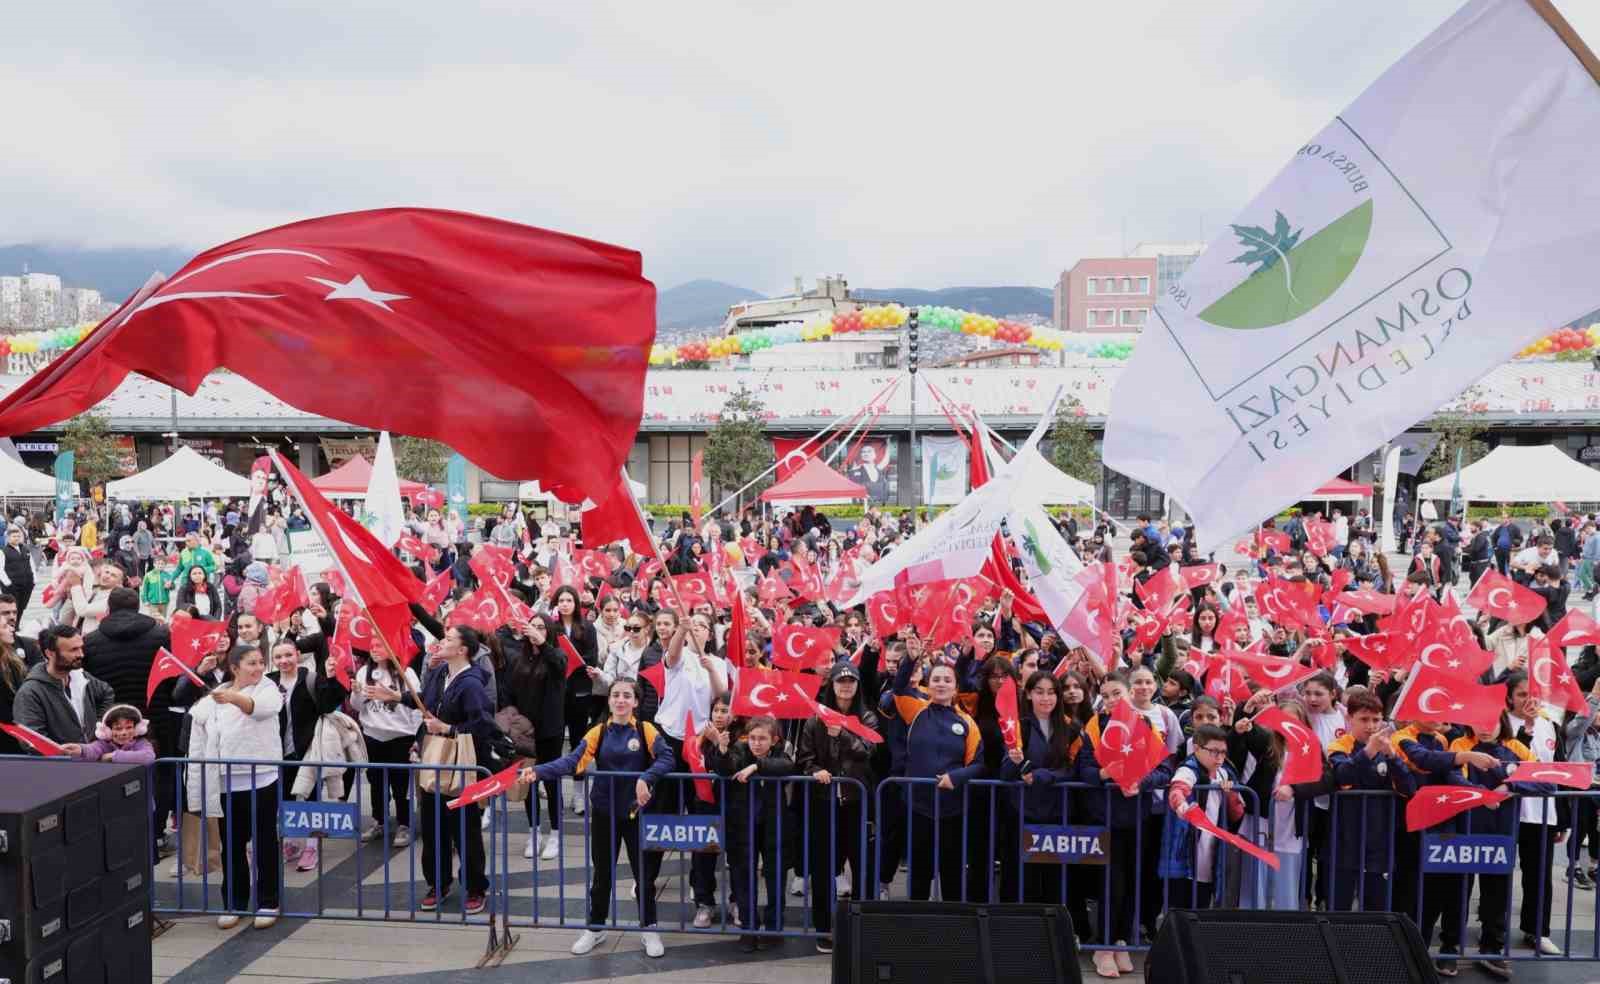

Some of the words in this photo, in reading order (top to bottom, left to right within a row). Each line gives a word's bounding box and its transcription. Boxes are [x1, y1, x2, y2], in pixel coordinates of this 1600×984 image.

[284, 811, 353, 830] ZABITA
[645, 824, 720, 843] ZABITA
[1026, 834, 1104, 855] ZABITA
[1427, 845, 1508, 864] ZABITA
